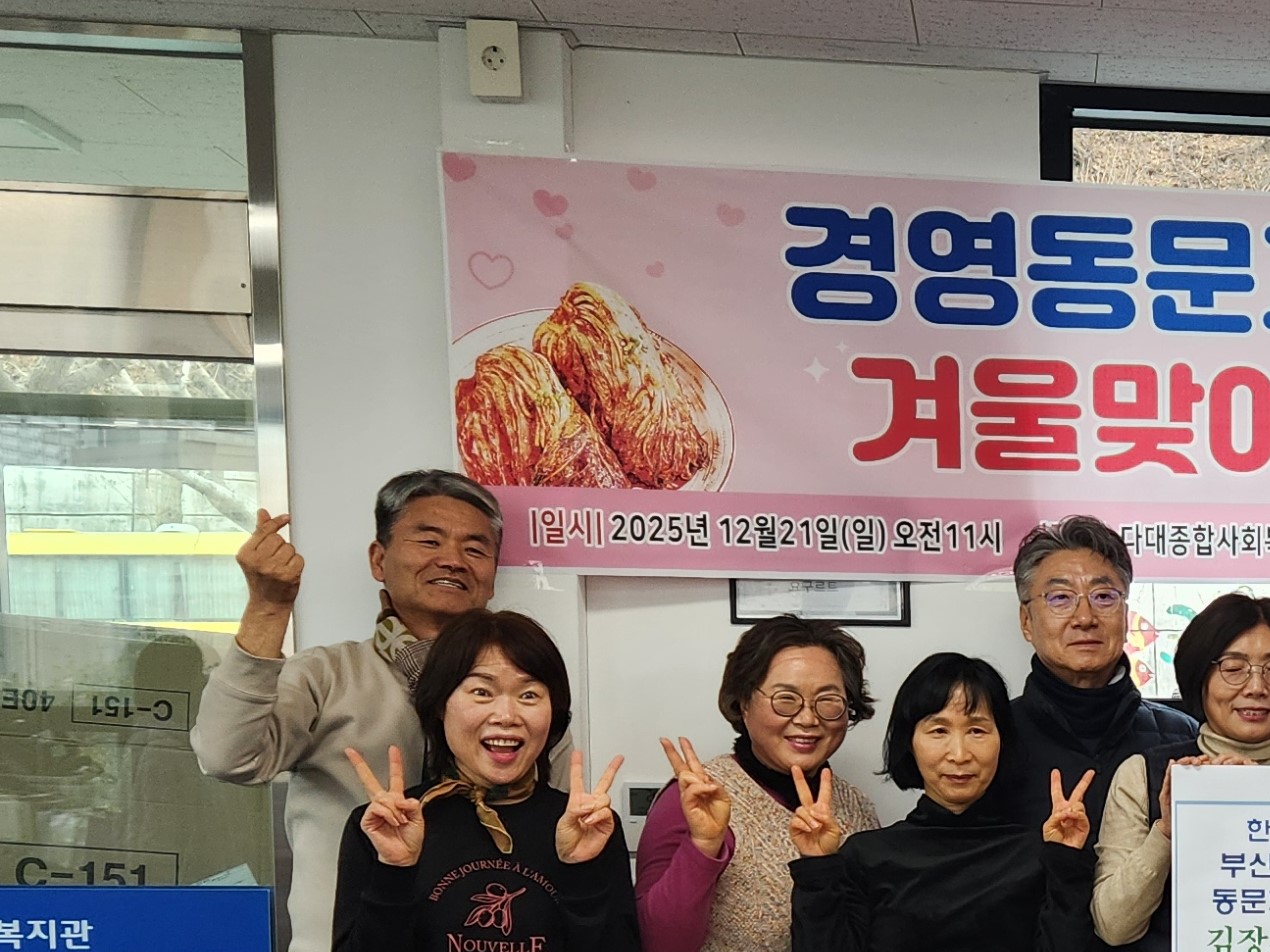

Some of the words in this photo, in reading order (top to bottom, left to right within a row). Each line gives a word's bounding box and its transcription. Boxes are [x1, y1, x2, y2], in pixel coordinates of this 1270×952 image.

[610, 513, 709, 548] 2025년
[719, 516, 885, 552] 12월21일(일)
[893, 519, 1003, 553] 오전11시
[91, 695, 173, 721] C-151
[428, 870, 461, 901] BONNE
[0, 919, 94, 949] 복지관
